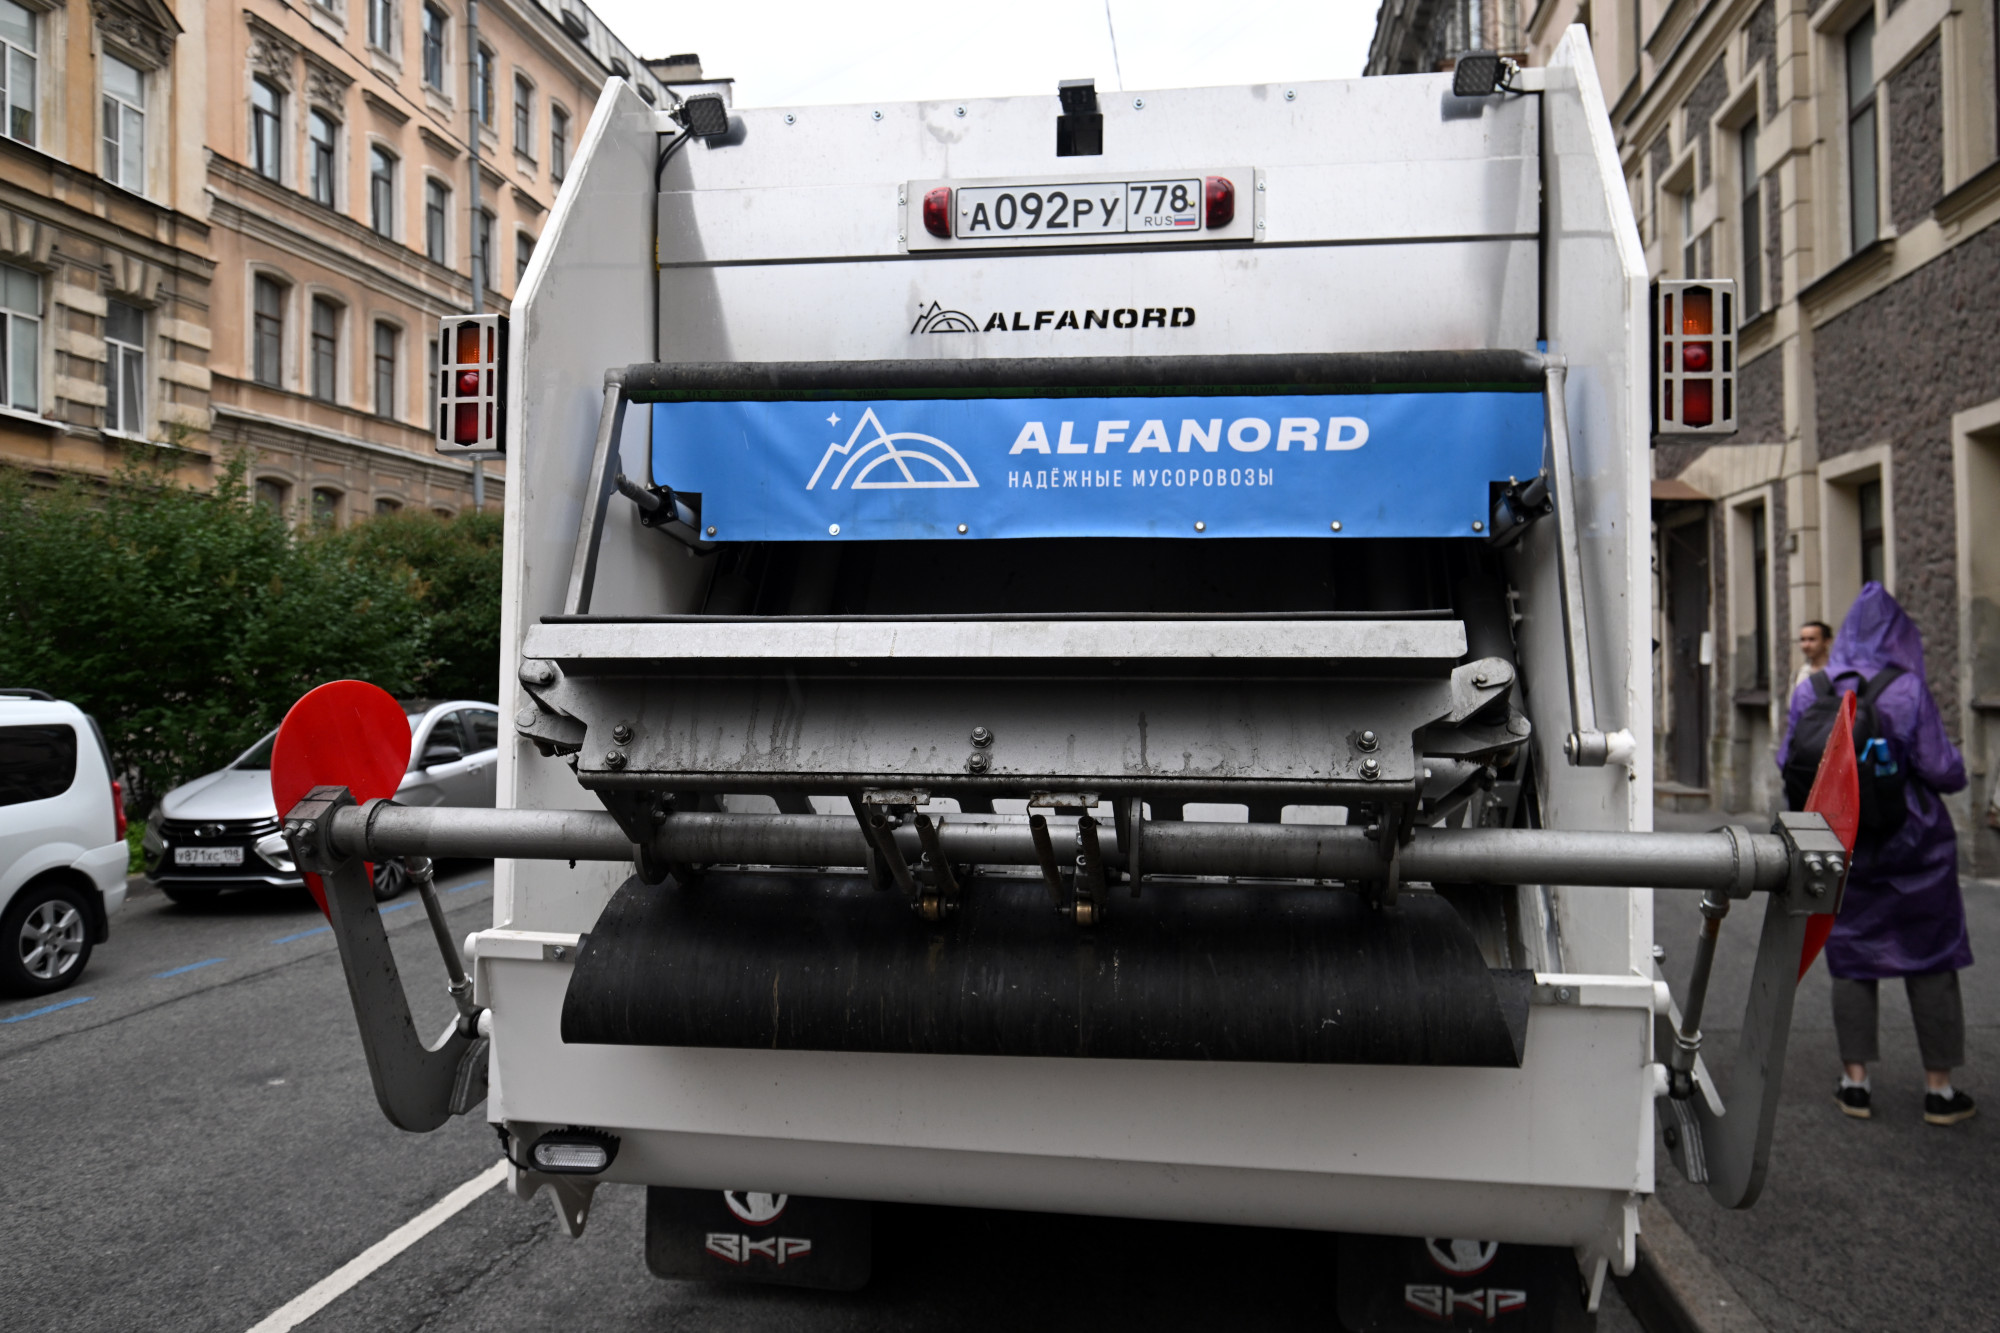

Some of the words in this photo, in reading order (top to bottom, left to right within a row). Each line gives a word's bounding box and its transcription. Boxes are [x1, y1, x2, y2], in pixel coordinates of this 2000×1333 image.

[968, 191, 1121, 232] А092РУ
[1129, 183, 1190, 215] 778
[1144, 215, 1174, 228] RUS
[982, 306, 1197, 333] ALFANORD
[1008, 416, 1371, 456] ALFANORD
[1008, 467, 1124, 490] НАДЁЖНЫЕ
[1132, 467, 1275, 488] МУСОРОВОЗЫ
